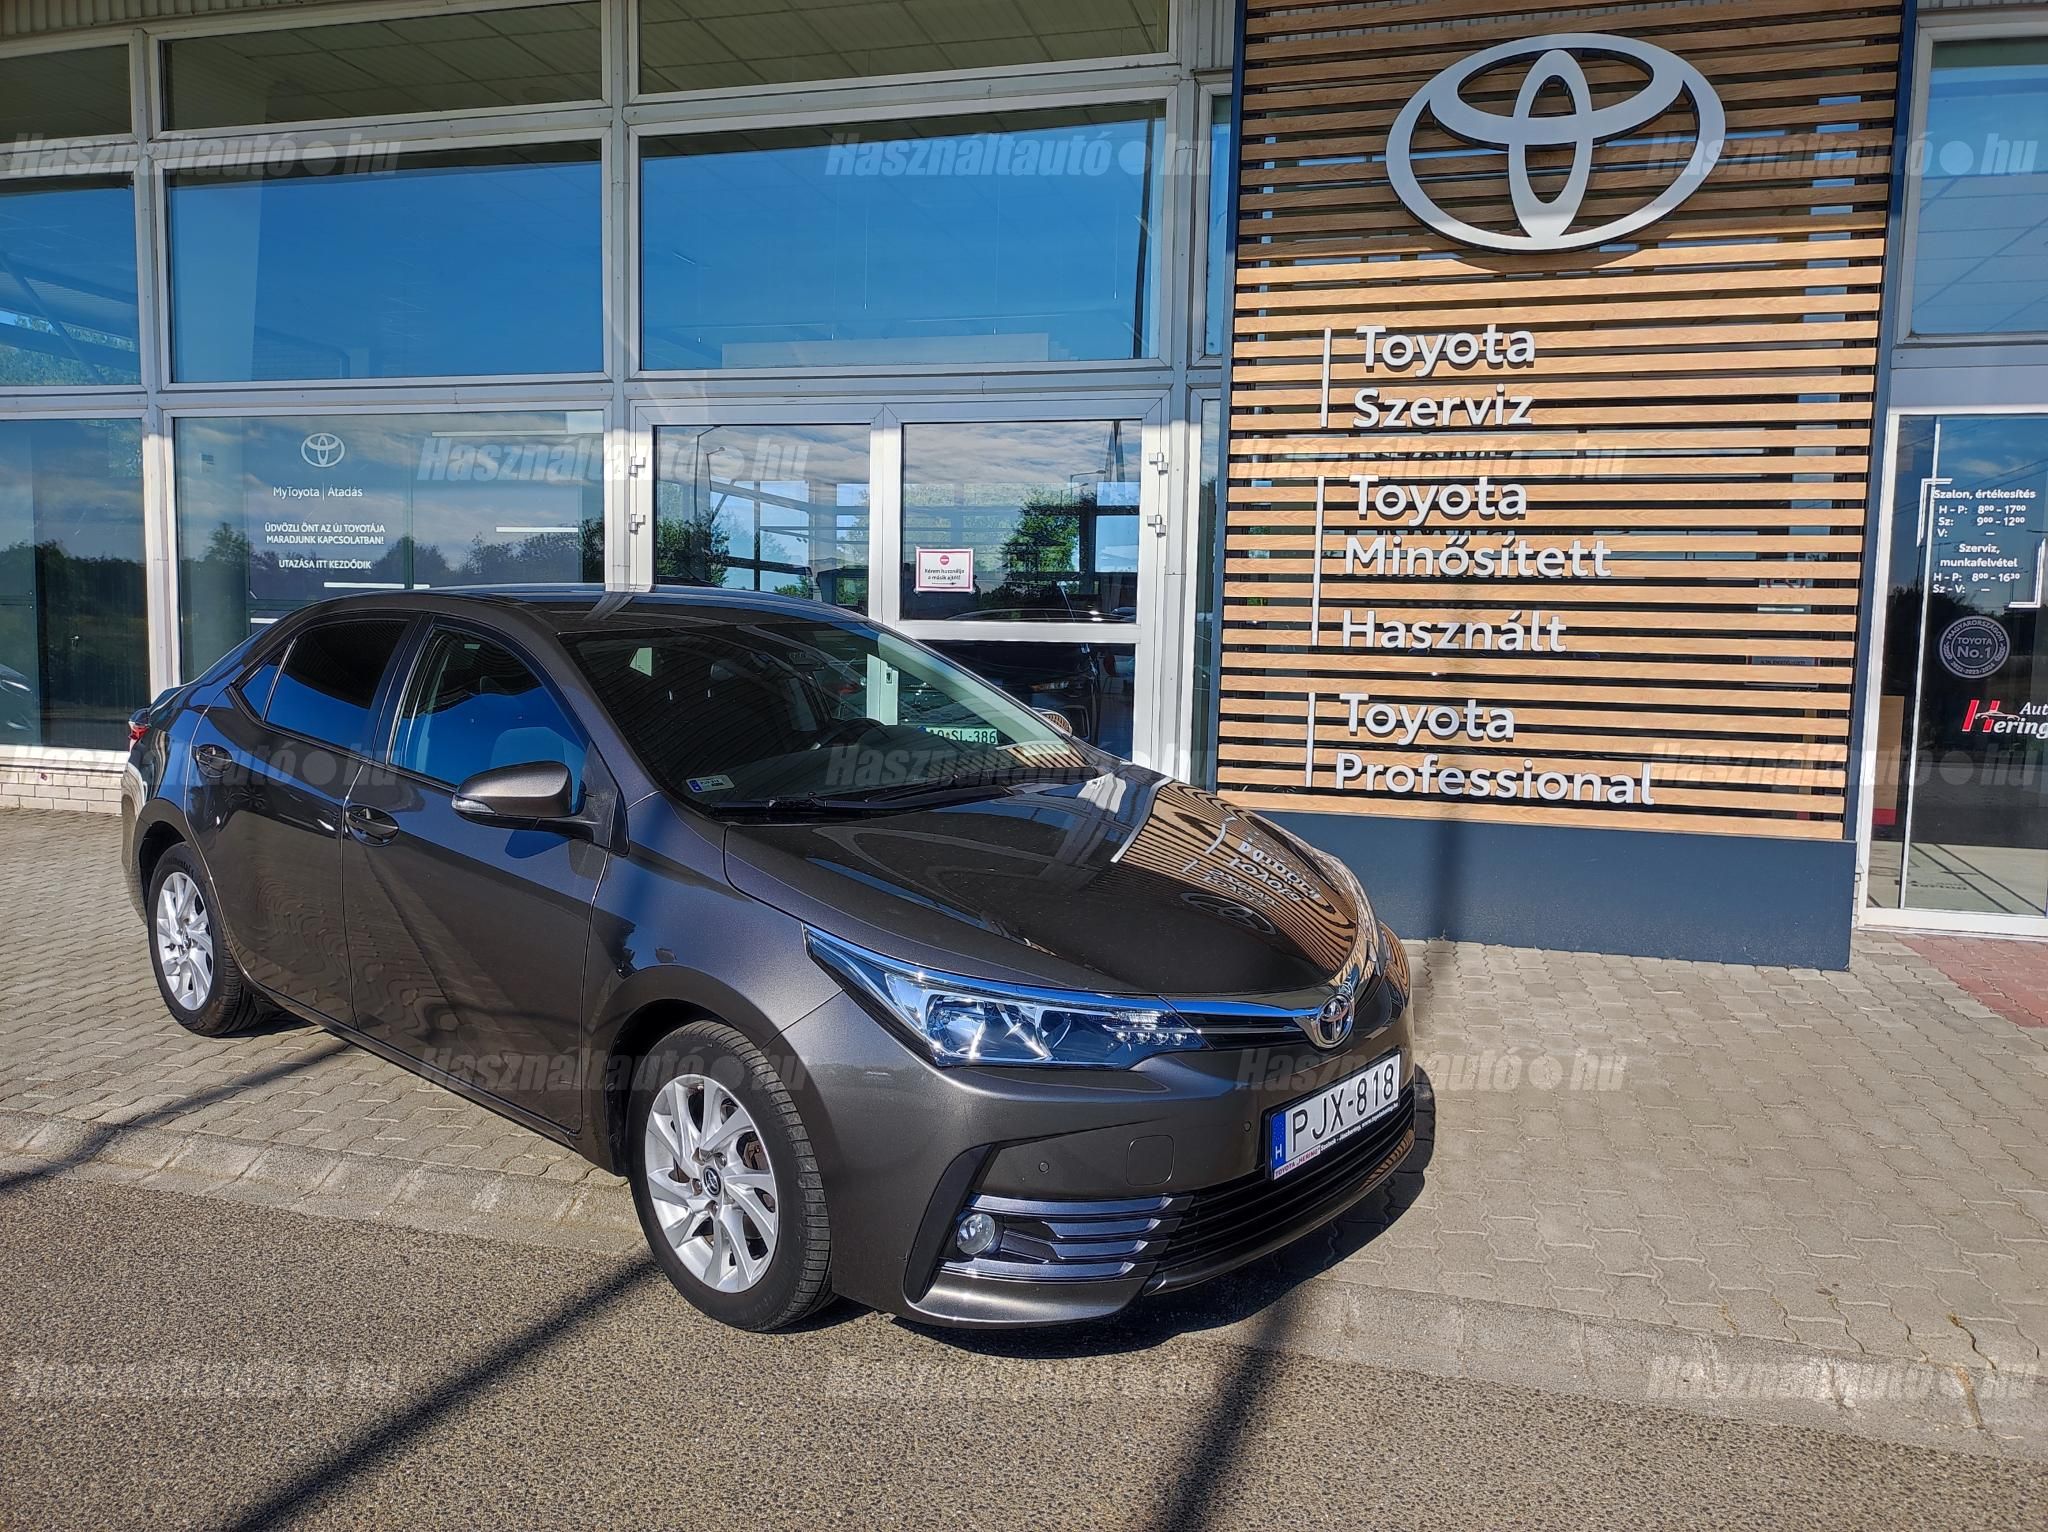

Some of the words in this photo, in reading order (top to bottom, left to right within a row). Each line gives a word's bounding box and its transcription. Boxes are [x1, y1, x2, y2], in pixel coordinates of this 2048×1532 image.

[1356, 324, 1536, 377] Toyota
[1353, 383, 1535, 428] Szerviz
[273, 486, 320, 499] MyToyota
[327, 483, 363, 497] Átadás
[1934, 489, 1973, 500] Szalon,
[1975, 489, 2037, 499] értékesítés
[1349, 474, 1527, 526] Toyota
[1939, 505, 1948, 514] H
[1957, 505, 1968, 514] P:
[301, 522, 319, 533] ÖNT
[320, 524, 331, 533] AZ
[332, 522, 343, 533] ÚJ
[344, 522, 386, 533] TOYOTÁJA
[1938, 517, 1954, 526] Sz:
[1937, 528, 1948, 538] V:
[266, 535, 316, 545] MARADJUNK
[317, 536, 385, 545] KAPCSOLATBAN!
[1958, 544, 2000, 554] Szerviz,
[1345, 535, 1612, 577] Minősített
[1940, 557, 2018, 568] munkafelvétel
[279, 559, 315, 569] UTAZÁSA
[316, 560, 328, 569] ITT
[329, 559, 372, 570] KEZDŐDIK
[1933, 572, 1942, 581] H
[1952, 572, 1962, 582] P:
[1342, 609, 1568, 652] Használt
[1946, 619, 2005, 642] MAGYARORSZÁGON
[1957, 637, 1992, 645] TOYOTA
[1339, 692, 1515, 745] Toyota
[1335, 752, 1655, 805] Professional
[1291, 1063, 1394, 1153] PJX-818
[1275, 1143, 1283, 1160] H
